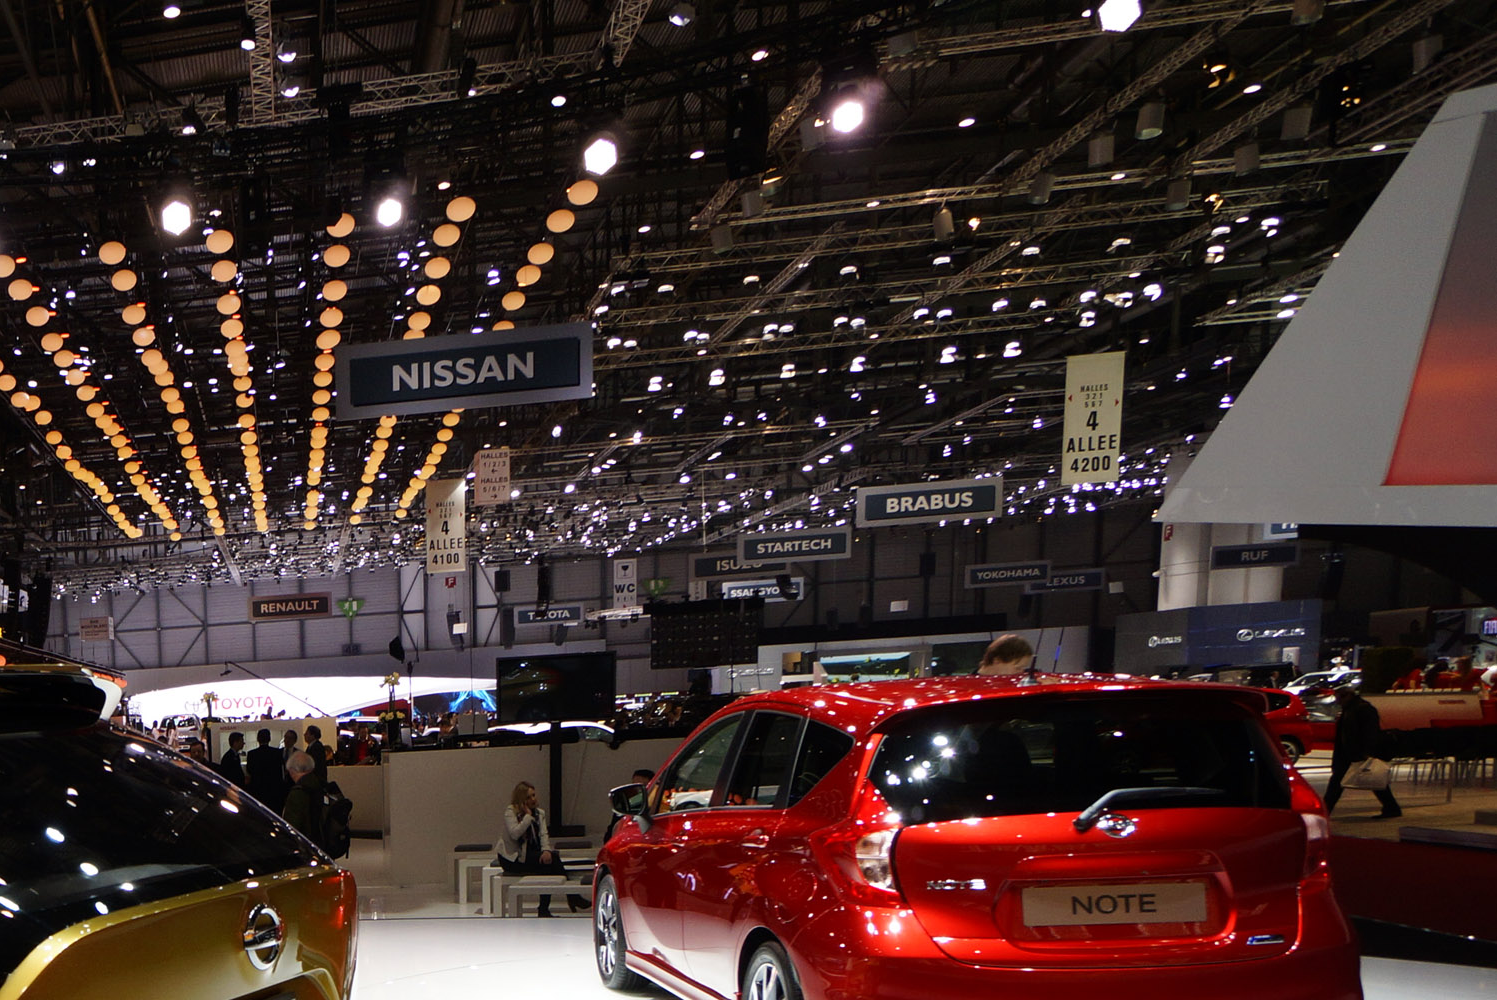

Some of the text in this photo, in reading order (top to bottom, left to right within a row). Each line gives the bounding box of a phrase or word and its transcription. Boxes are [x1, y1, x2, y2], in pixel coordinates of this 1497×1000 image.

[392, 351, 535, 392] NISSAN
[1080, 384, 1109, 392] HALLES
[1086, 411, 1099, 431] 4
[1066, 434, 1117, 453] ALLEE
[480, 452, 509, 460] HALLES
[1070, 455, 1111, 473] 4200
[886, 491, 973, 514] BRABUS
[441, 520, 450, 535] 4
[429, 538, 463, 551] ALLEE
[757, 538, 832, 554] STARTECH
[432, 553, 460, 564] 4100
[1241, 551, 1269, 561] RUF
[977, 568, 1041, 580] YOKOHAMA
[615, 583, 635, 593] WC
[260, 599, 320, 614] RENAULT
[527, 609, 570, 620] TOTA
[1484, 620, 1497, 634] FIA
[214, 696, 274, 710] TOYOTA
[926, 878, 986, 890] NOTE
[1071, 893, 1158, 915] NOTE
